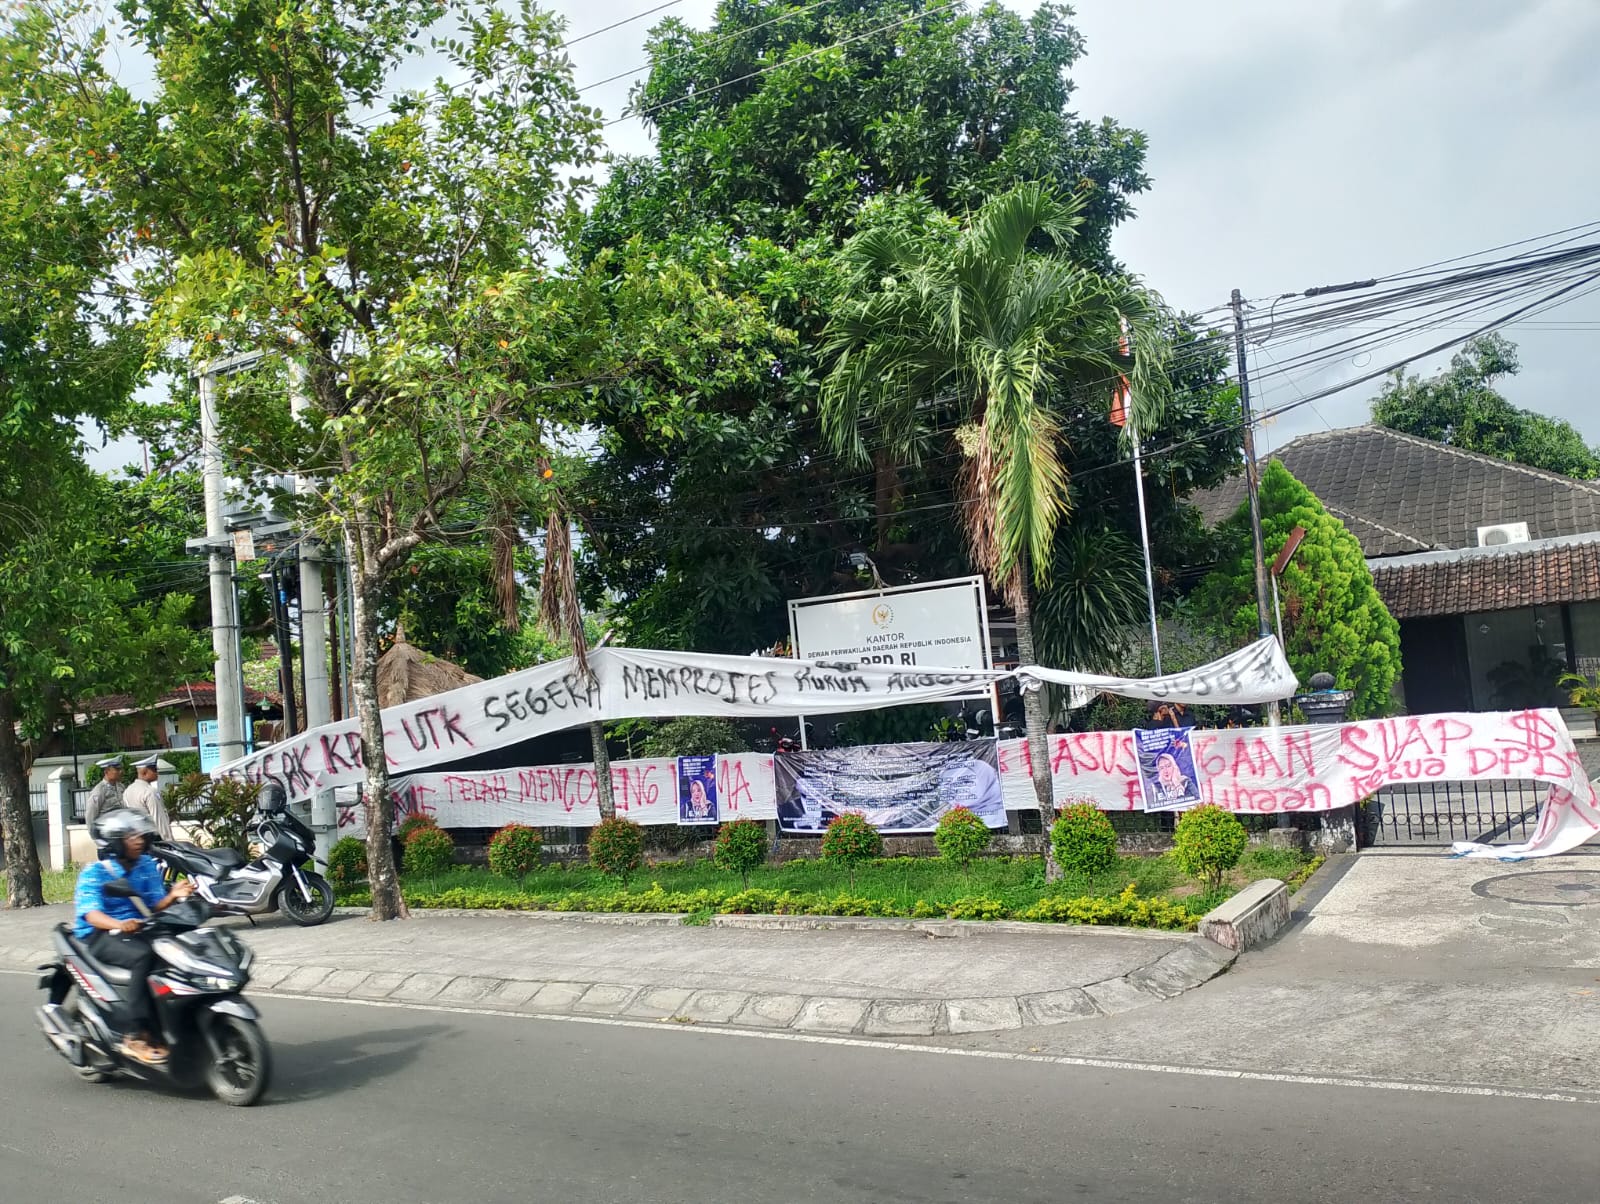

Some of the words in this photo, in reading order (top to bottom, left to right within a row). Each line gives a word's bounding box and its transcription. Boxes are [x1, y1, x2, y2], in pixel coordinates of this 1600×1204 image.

[807, 651, 830, 659] DEWAN
[830, 646, 871, 656] PERWAKILAN
[872, 643, 898, 652] DAERAH
[899, 639, 933, 649] REPUBLIK
[934, 636, 972, 646] INDONESIA
[866, 632, 905, 644] KANTOR
[401, 704, 475, 752] UTK
[444, 775, 508, 804] TELAH
